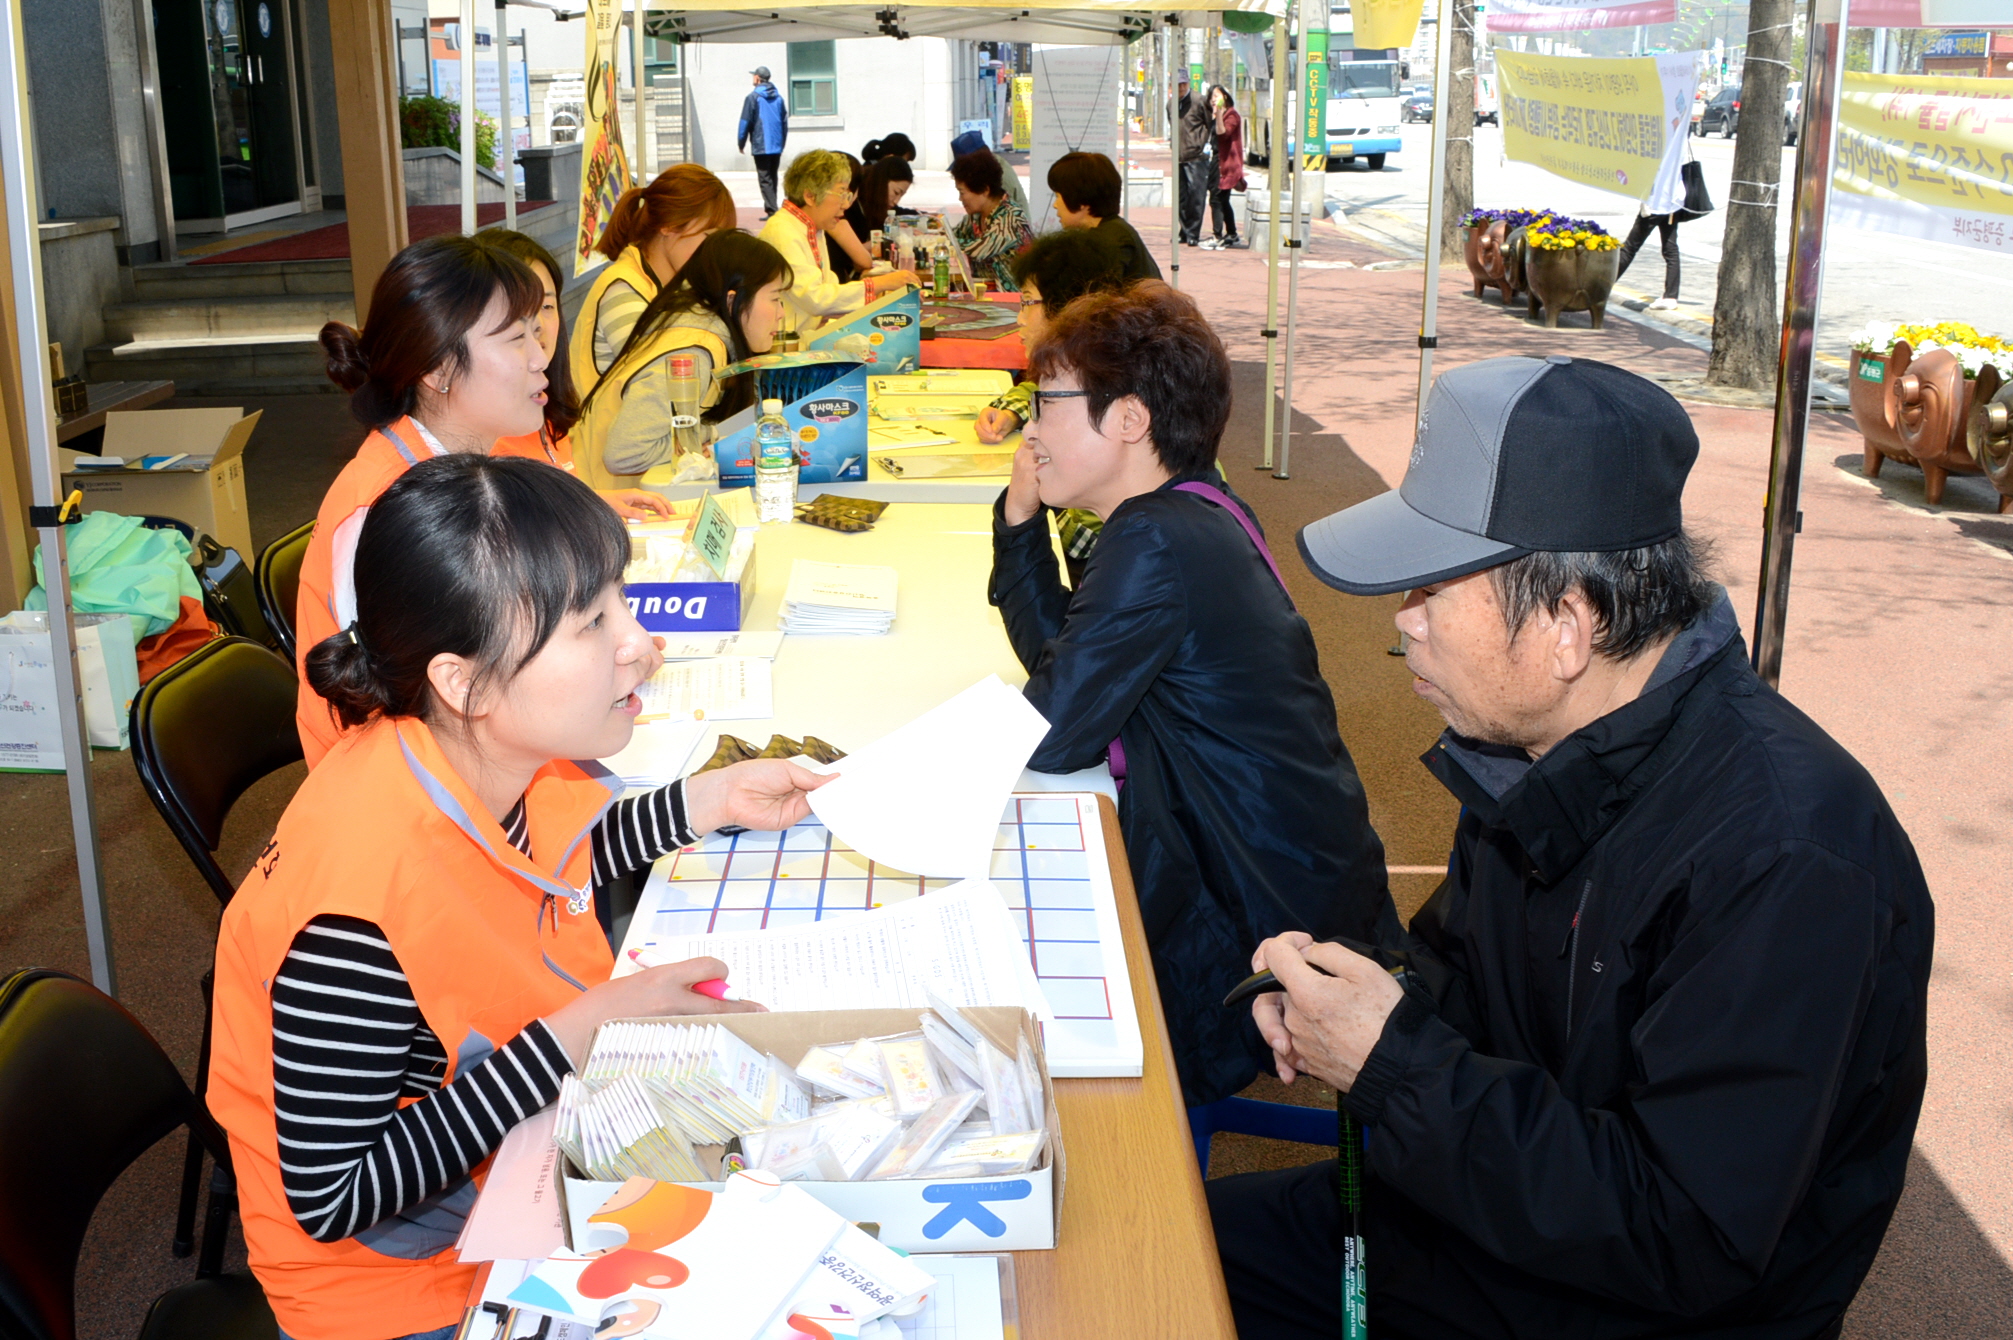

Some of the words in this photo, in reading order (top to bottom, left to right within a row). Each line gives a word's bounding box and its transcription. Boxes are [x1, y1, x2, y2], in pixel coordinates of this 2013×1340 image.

[1309, 69, 1319, 107] CCTV
[1308, 108, 1319, 138] 작동중
[809, 402, 850, 414] 황사마스크
[711, 508, 729, 540] 검사
[703, 529, 723, 561] 치매
[538, 1174, 548, 1183] 또는
[532, 1190, 543, 1204] 물고기
[818, 1250, 894, 1306] 광역정신건강증
